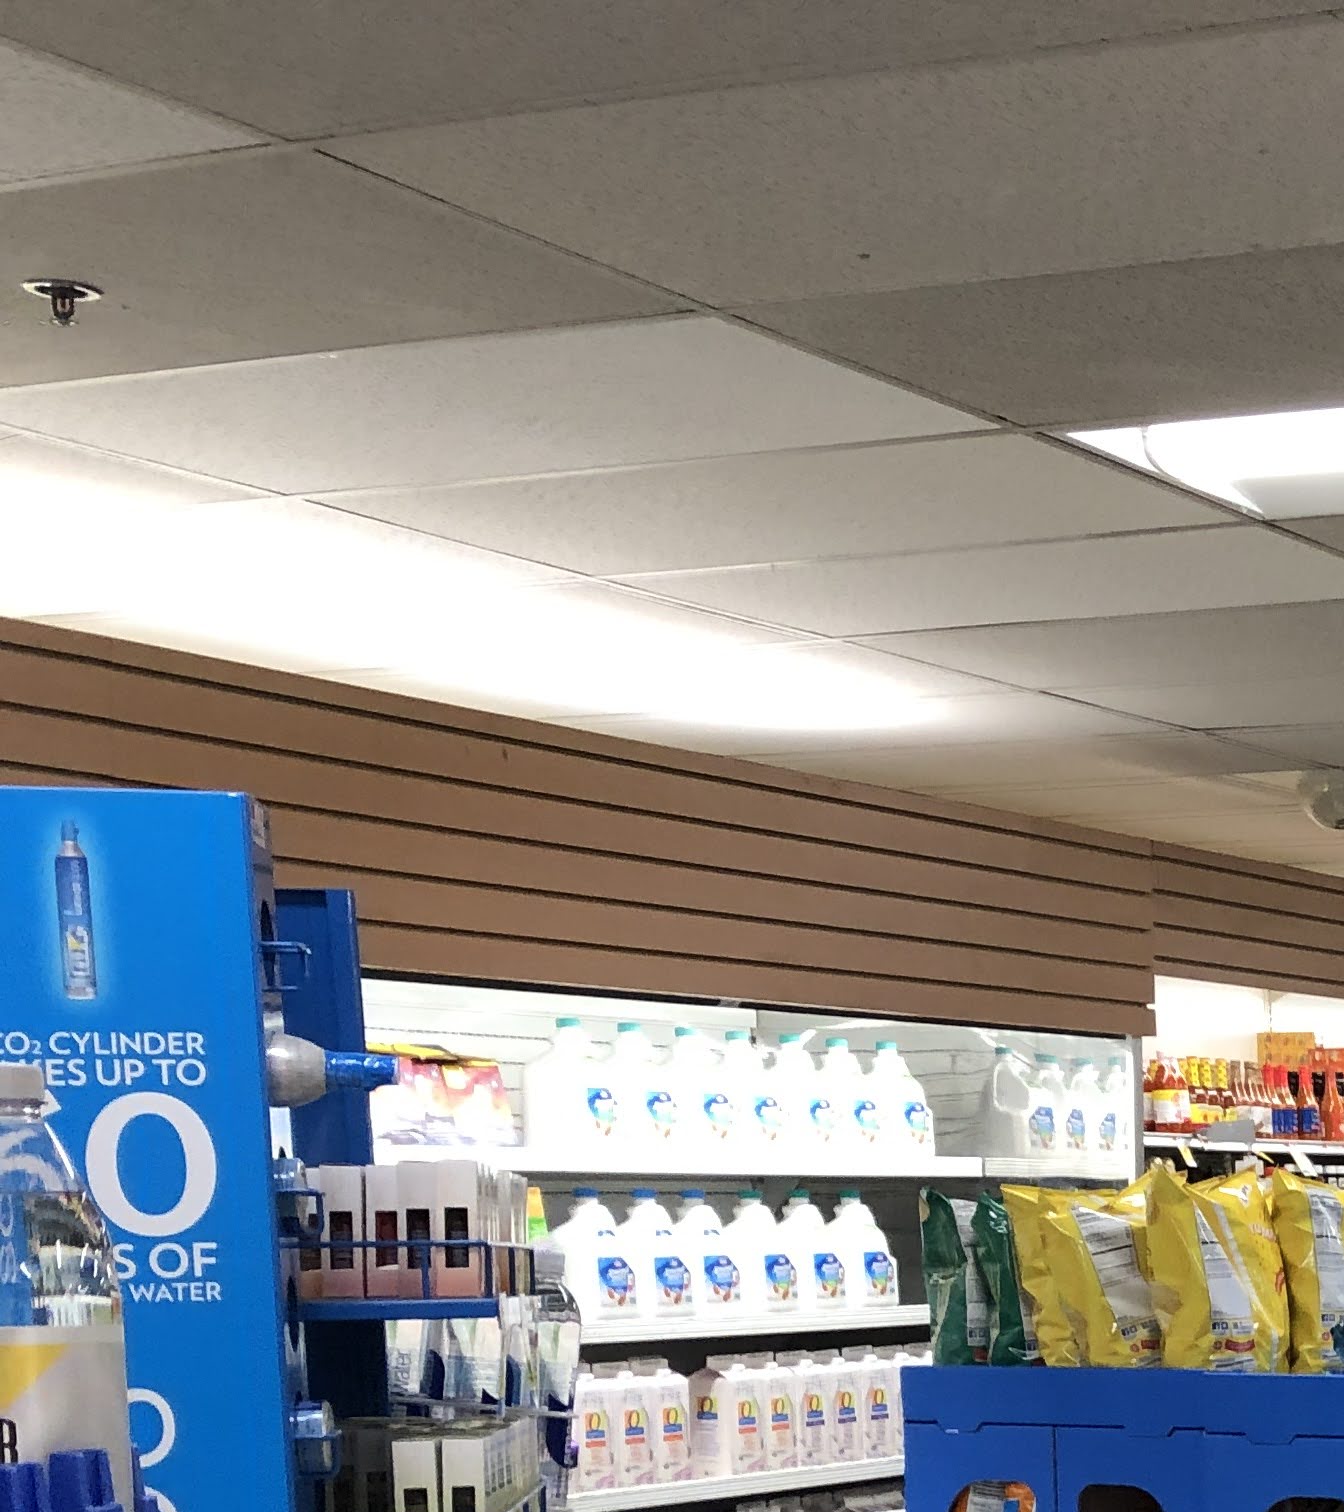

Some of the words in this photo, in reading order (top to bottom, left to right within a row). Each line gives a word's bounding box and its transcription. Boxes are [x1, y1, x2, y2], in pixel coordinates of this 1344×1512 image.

[49, 1031, 206, 1056] CYLINDER
[95, 1058, 146, 1087] UP
[151, 1058, 208, 1087] TO
[149, 1241, 218, 1280] OF
[129, 1281, 222, 1303] WATER
